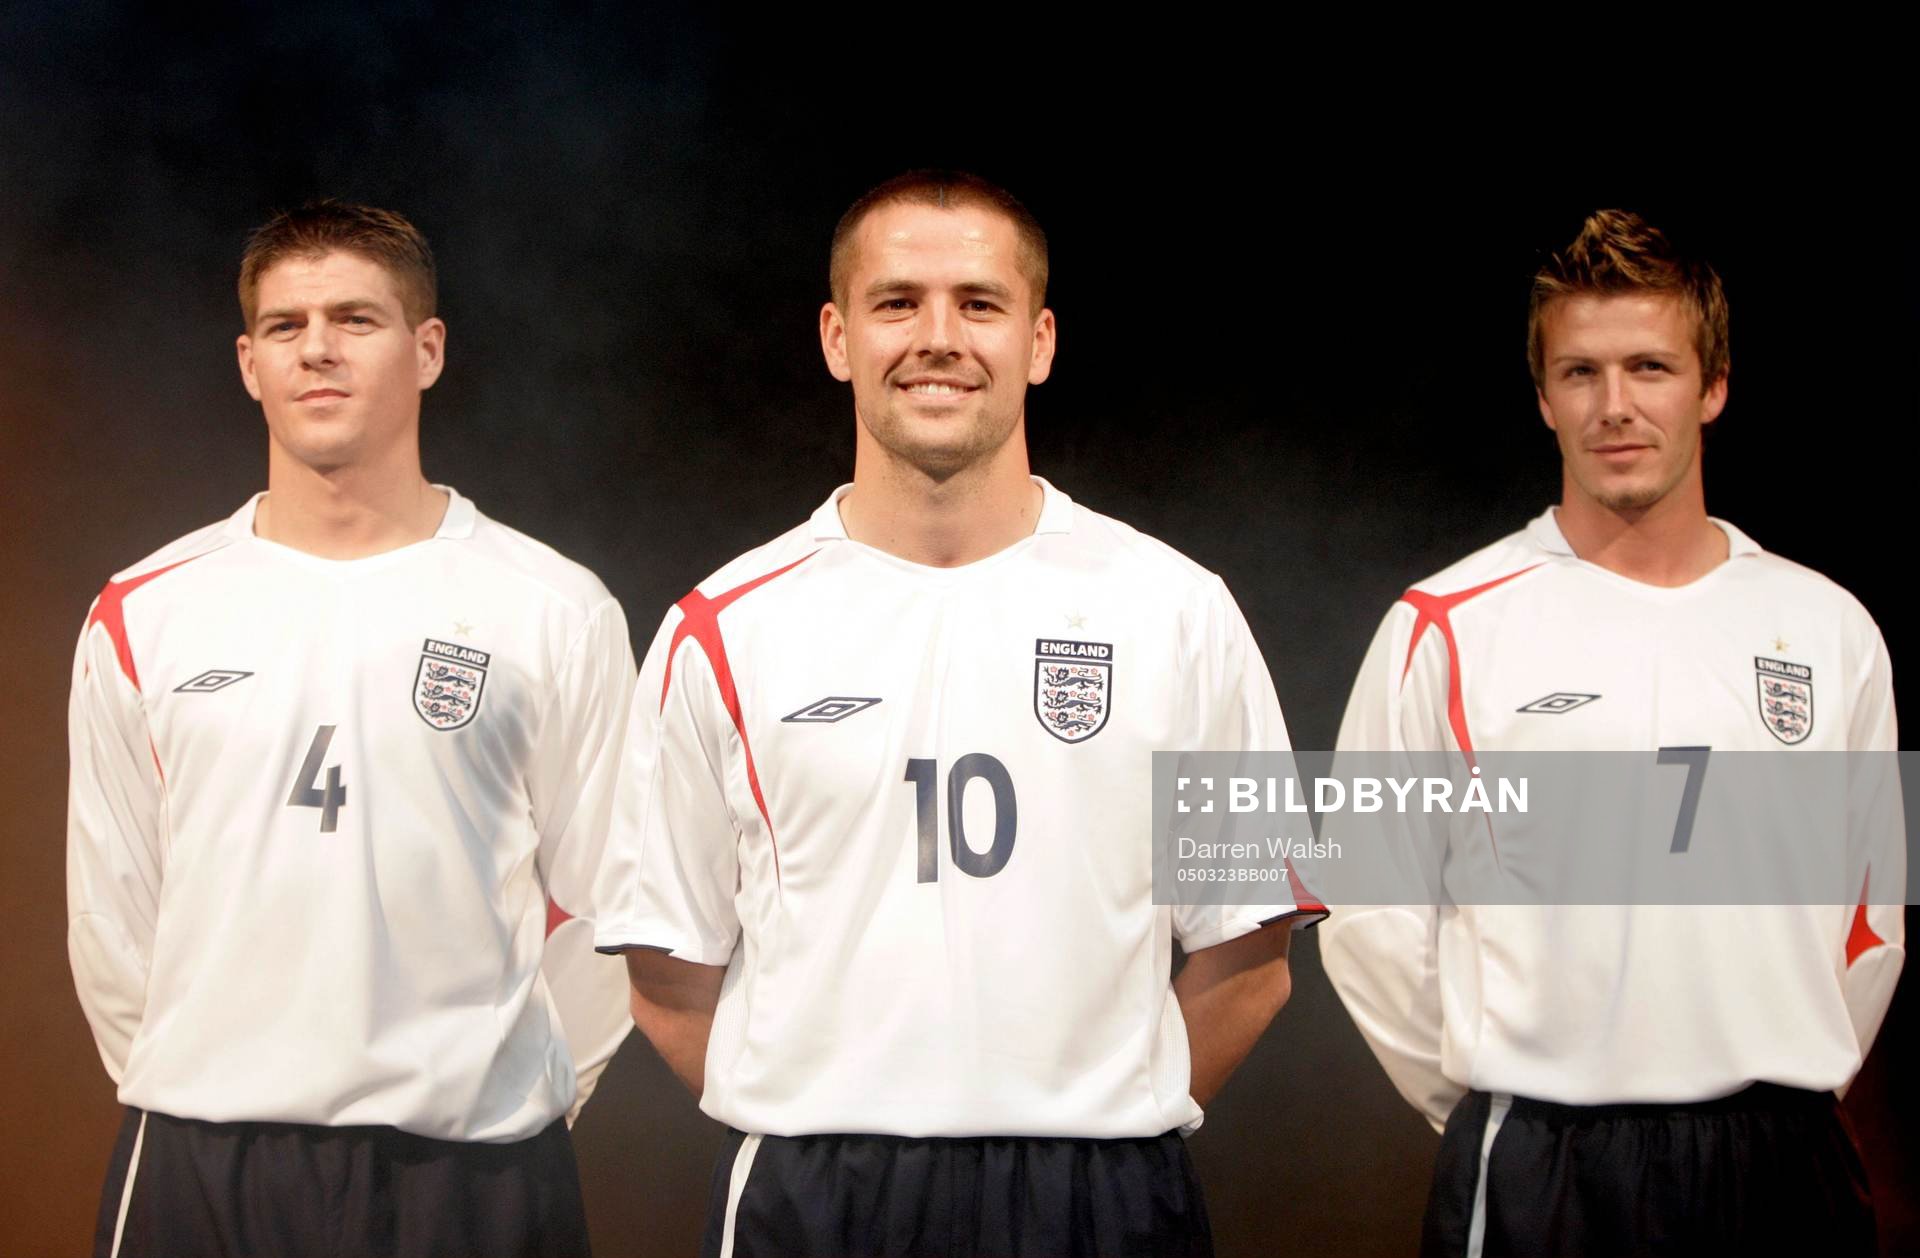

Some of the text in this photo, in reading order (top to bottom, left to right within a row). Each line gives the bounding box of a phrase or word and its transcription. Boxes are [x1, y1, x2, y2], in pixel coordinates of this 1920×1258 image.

[426, 641, 487, 664] ENGLAND
[1040, 642, 1109, 658] ENGLAND
[1758, 659, 1809, 678] ENGLAND
[286, 725, 347, 833] 4
[1656, 745, 1713, 854] 7
[903, 752, 1018, 884] 10
